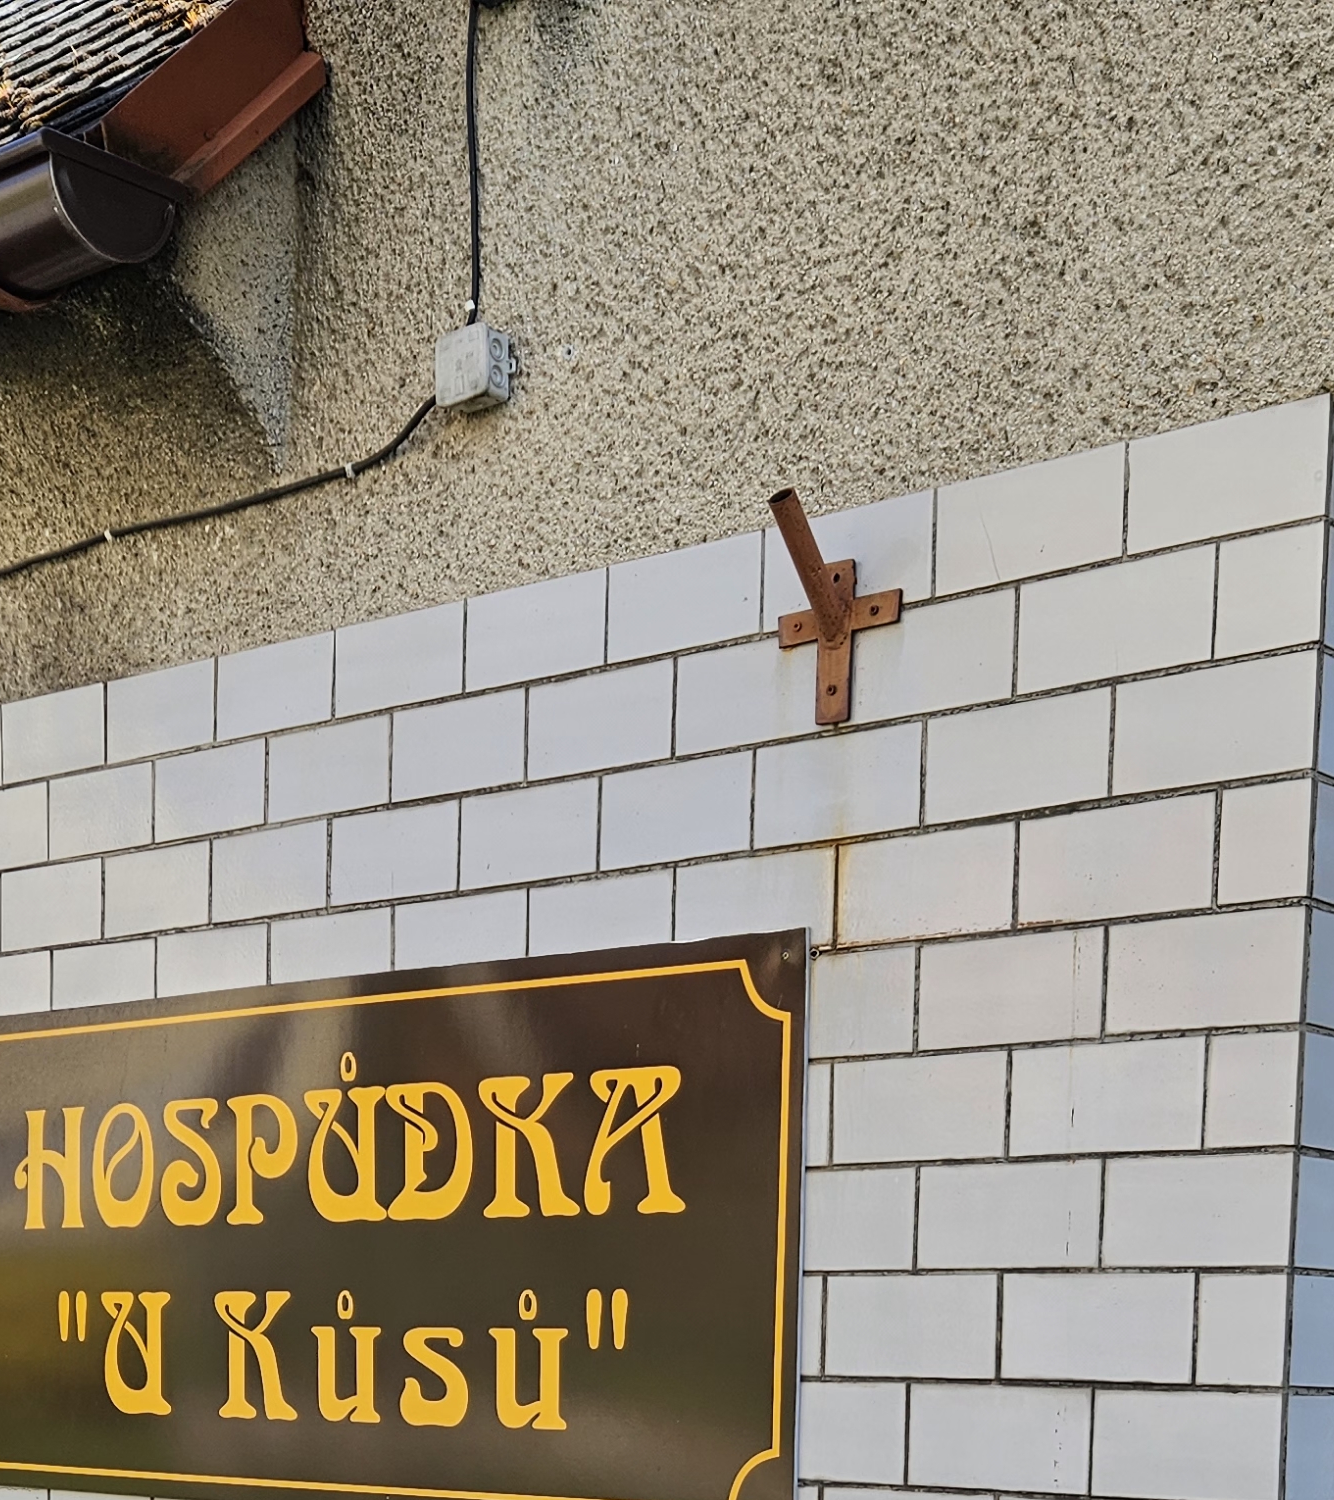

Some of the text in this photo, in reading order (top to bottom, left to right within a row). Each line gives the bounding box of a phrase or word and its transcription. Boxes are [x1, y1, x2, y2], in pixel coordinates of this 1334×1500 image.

[14, 1051, 687, 1230] HOSPŮDKA
[57, 1287, 629, 1430] "U Kůsů"
